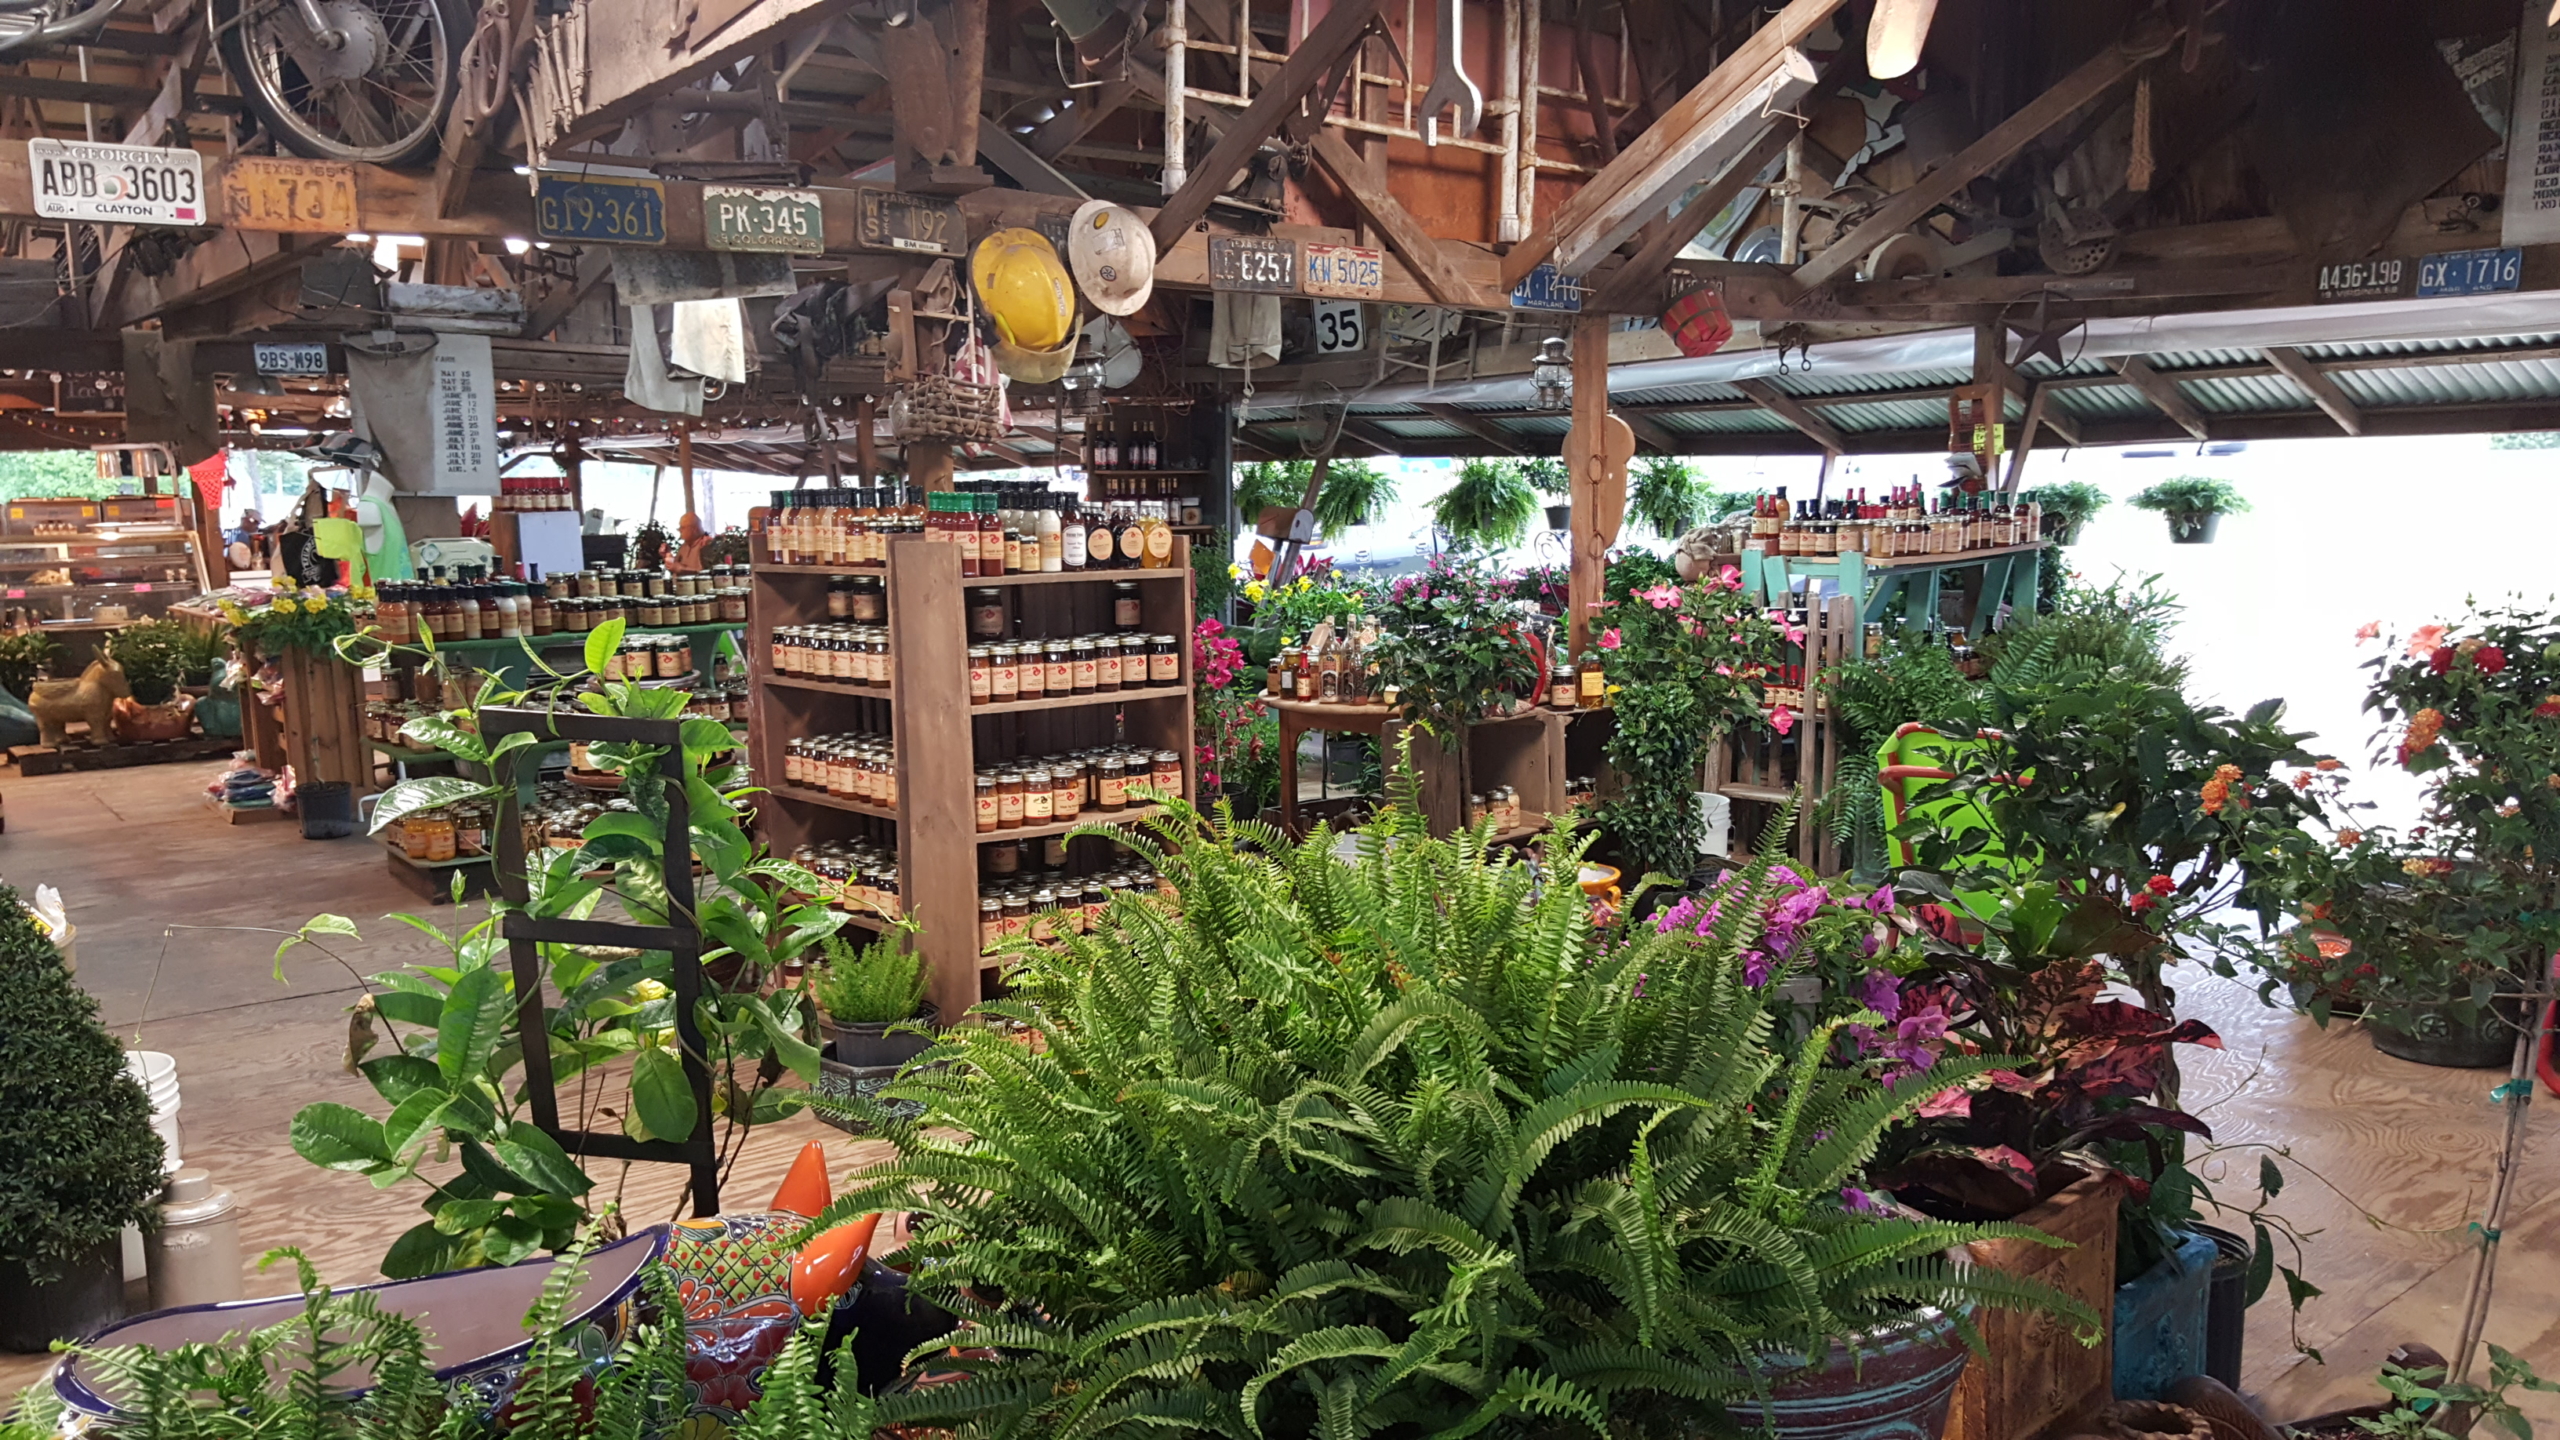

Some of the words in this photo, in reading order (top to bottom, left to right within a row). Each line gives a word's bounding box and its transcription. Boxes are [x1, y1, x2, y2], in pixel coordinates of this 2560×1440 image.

[71, 147, 164, 165] GEORGIA
[252, 162, 303, 176] TEXAS
[94, 203, 153, 216] CLAYTON
[909, 206, 950, 244] 192
[732, 233, 800, 247] COLORADO
[1337, 258, 1379, 287] 5025
[1527, 299, 1565, 309] MARYLAND
[1320, 308, 1360, 351] 35
[441, 370, 456, 378] MAY
